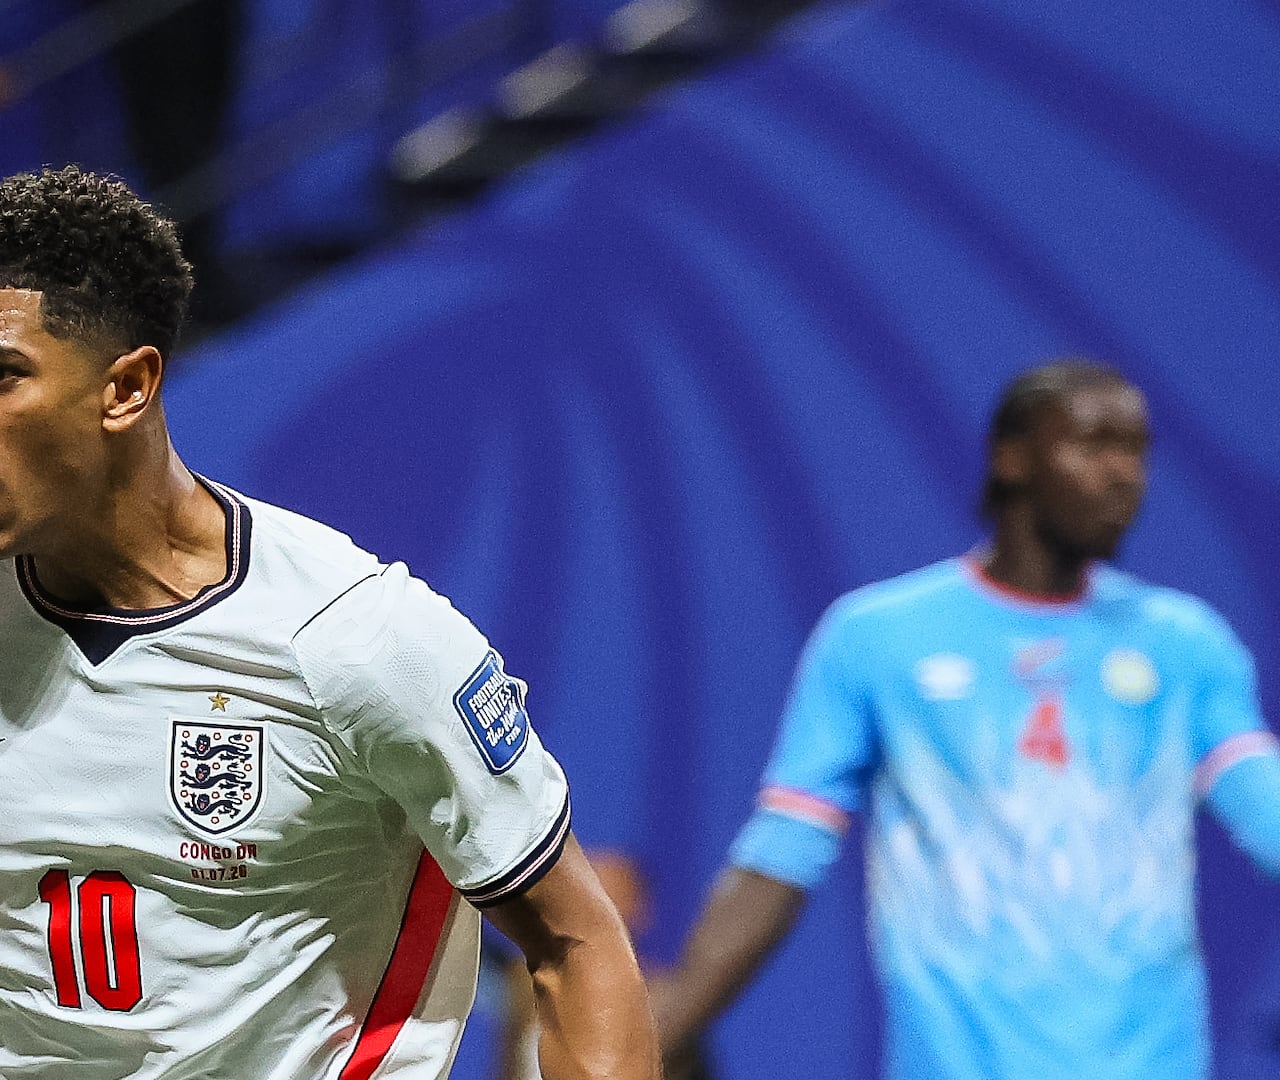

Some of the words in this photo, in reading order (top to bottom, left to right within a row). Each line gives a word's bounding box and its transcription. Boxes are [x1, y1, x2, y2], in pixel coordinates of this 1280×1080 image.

[476, 680, 512, 730] UNITES
[1016, 691, 1071, 769] 4
[486, 727, 505, 747] the
[180, 842, 232, 860] CONGO
[236, 843, 257, 860] DR
[38, 868, 144, 1012] 10
